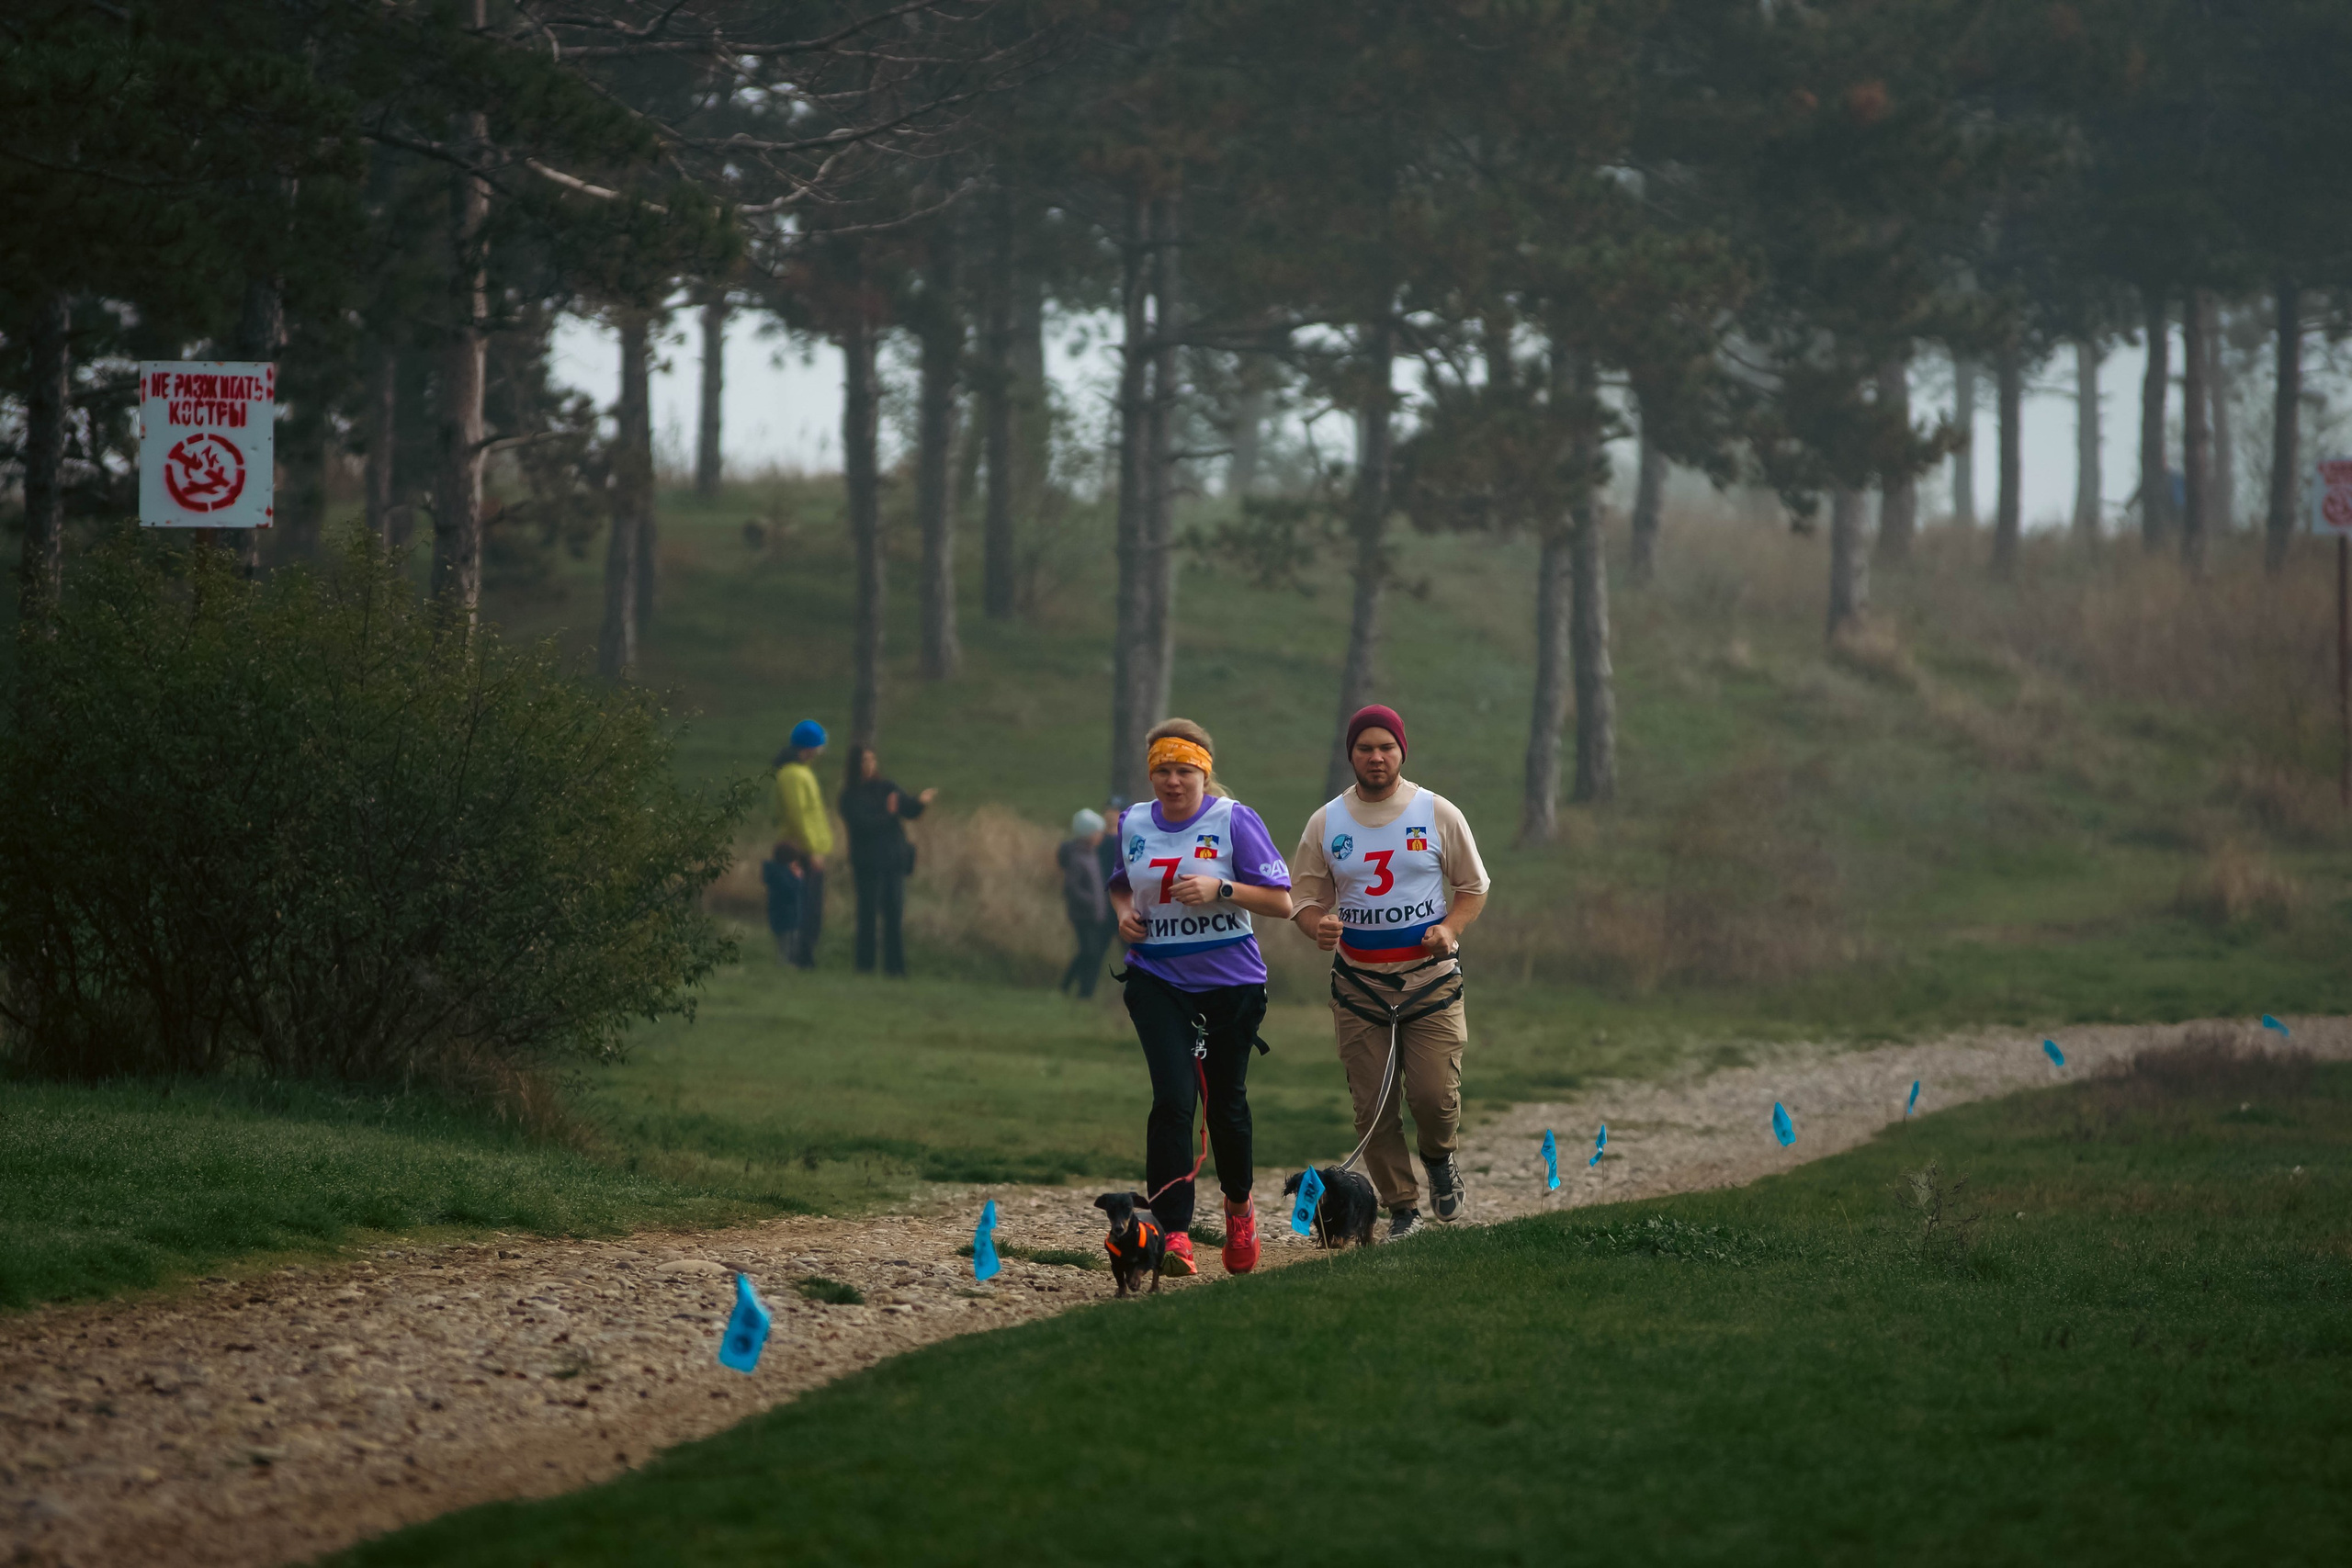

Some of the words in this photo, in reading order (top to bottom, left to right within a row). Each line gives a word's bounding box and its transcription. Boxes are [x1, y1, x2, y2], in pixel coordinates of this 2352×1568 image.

[151, 372, 171, 399] НЕ
[174, 374, 264, 401] РАЗЖИГАТЬ
[168, 400, 247, 428] КОСТРЫ
[1148, 856, 1183, 905] 7
[1363, 850, 1396, 897] 3
[1142, 912, 1241, 938] ТИГОРСК
